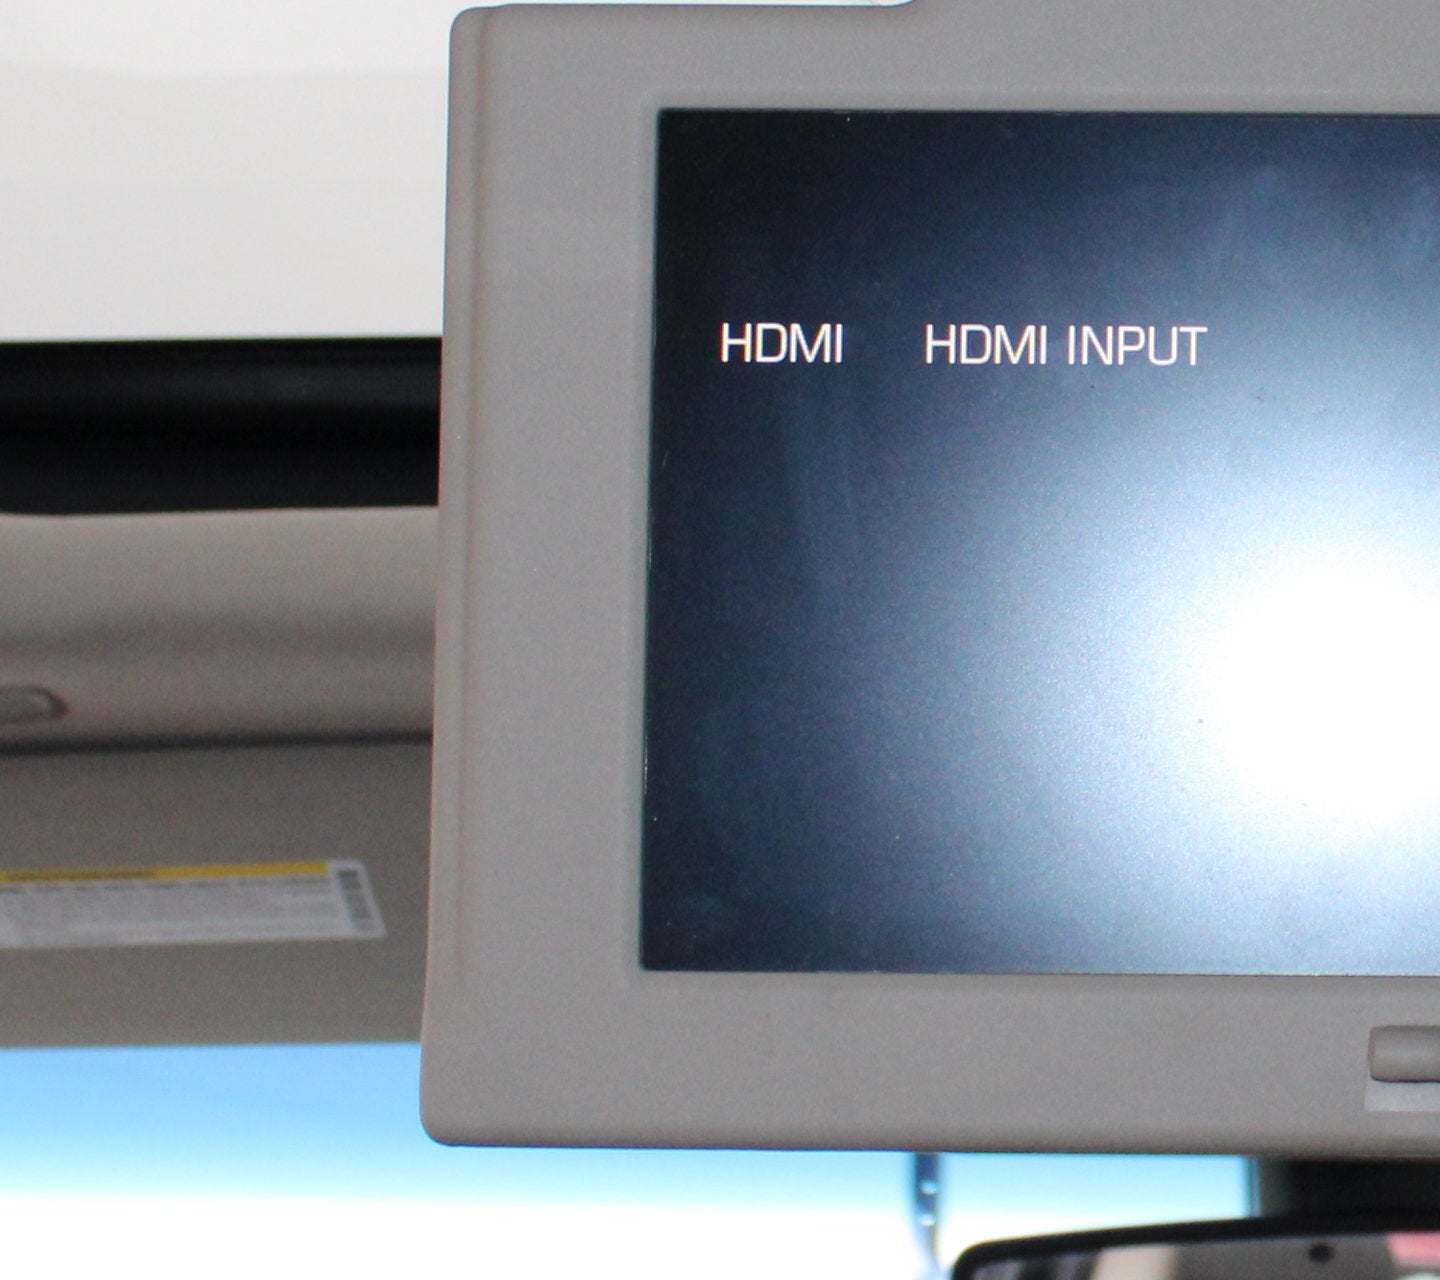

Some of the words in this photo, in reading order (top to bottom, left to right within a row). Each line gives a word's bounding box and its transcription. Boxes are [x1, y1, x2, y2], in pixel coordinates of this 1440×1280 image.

[719, 321, 844, 364] HDMI
[924, 323, 1049, 365] HDMI
[1067, 324, 1209, 367] INPUT
